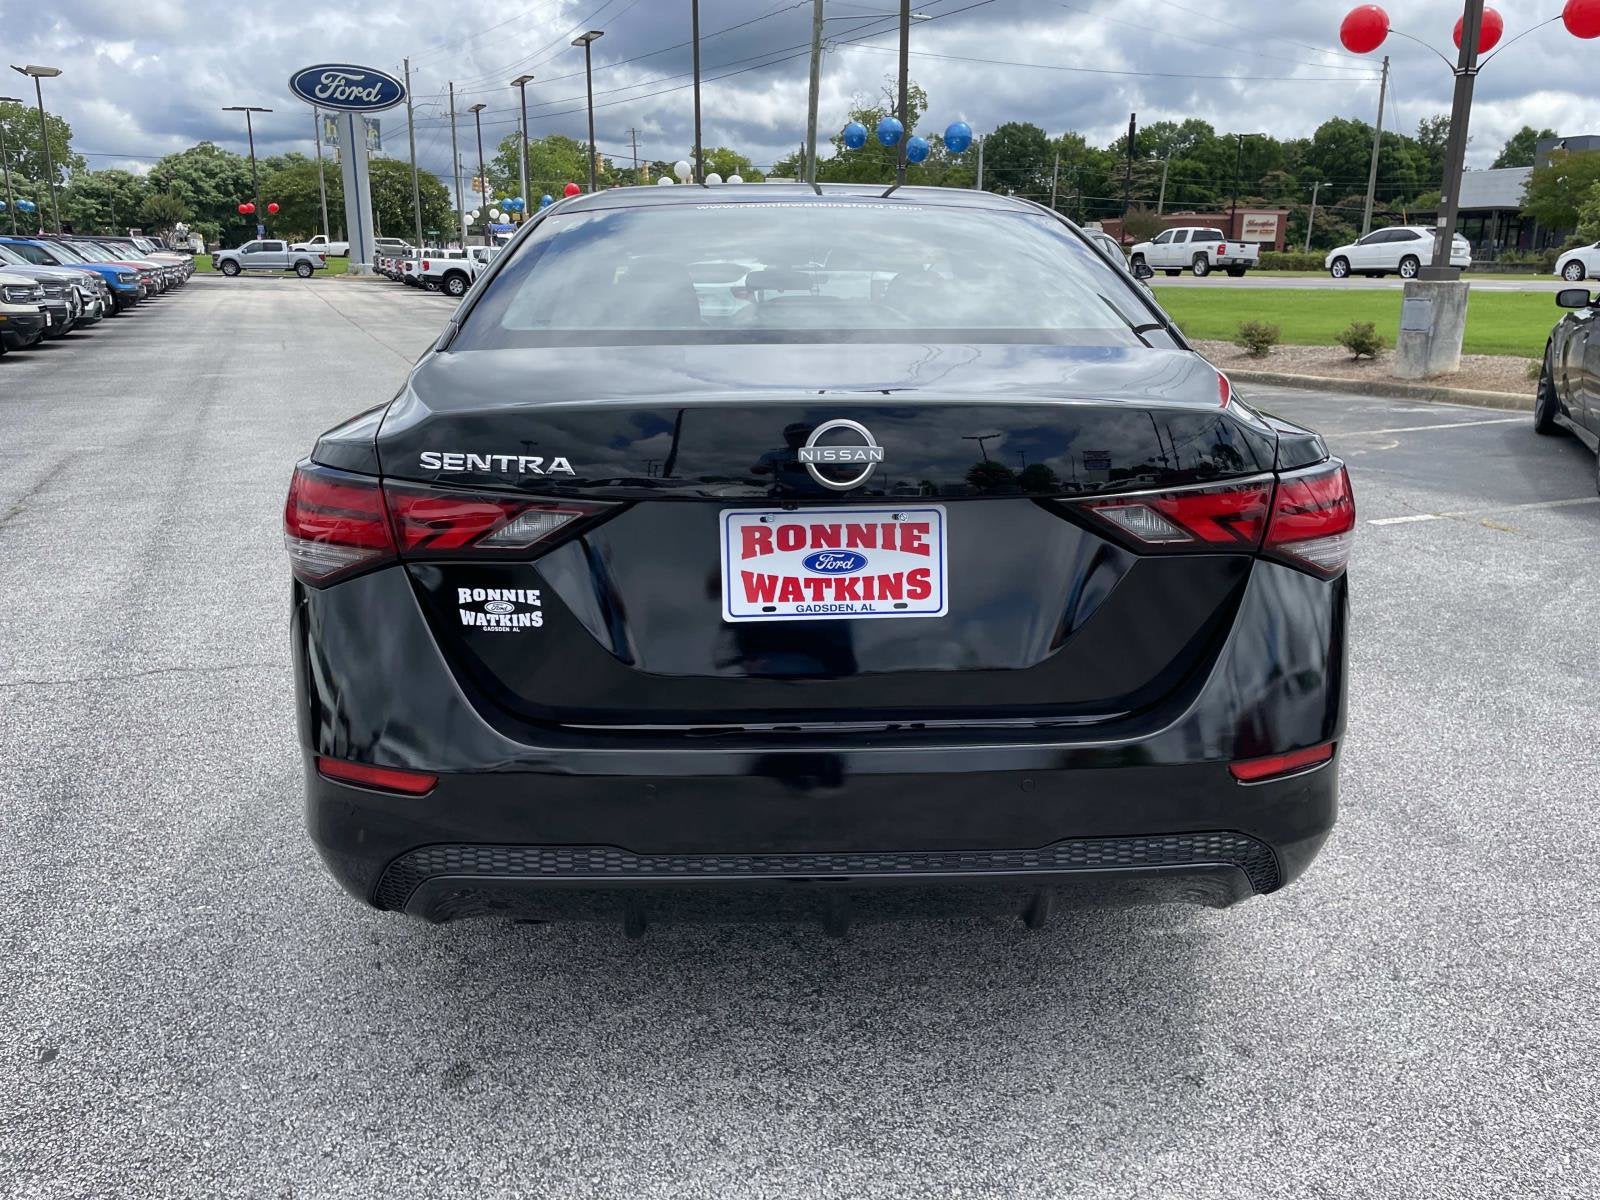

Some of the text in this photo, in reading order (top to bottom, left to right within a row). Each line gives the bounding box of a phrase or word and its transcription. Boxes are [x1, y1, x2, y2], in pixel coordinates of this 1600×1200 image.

[315, 71, 382, 102] Ford
[419, 452, 576, 476] SENTRA
[801, 450, 882, 461] NISSAN
[741, 522, 930, 560] RONNIE
[815, 553, 855, 570] Ford
[741, 568, 932, 603] WATKINS
[457, 588, 541, 607] RONNIE
[459, 608, 544, 628] WATKINS
[796, 603, 876, 613] GADSDEN, AL
